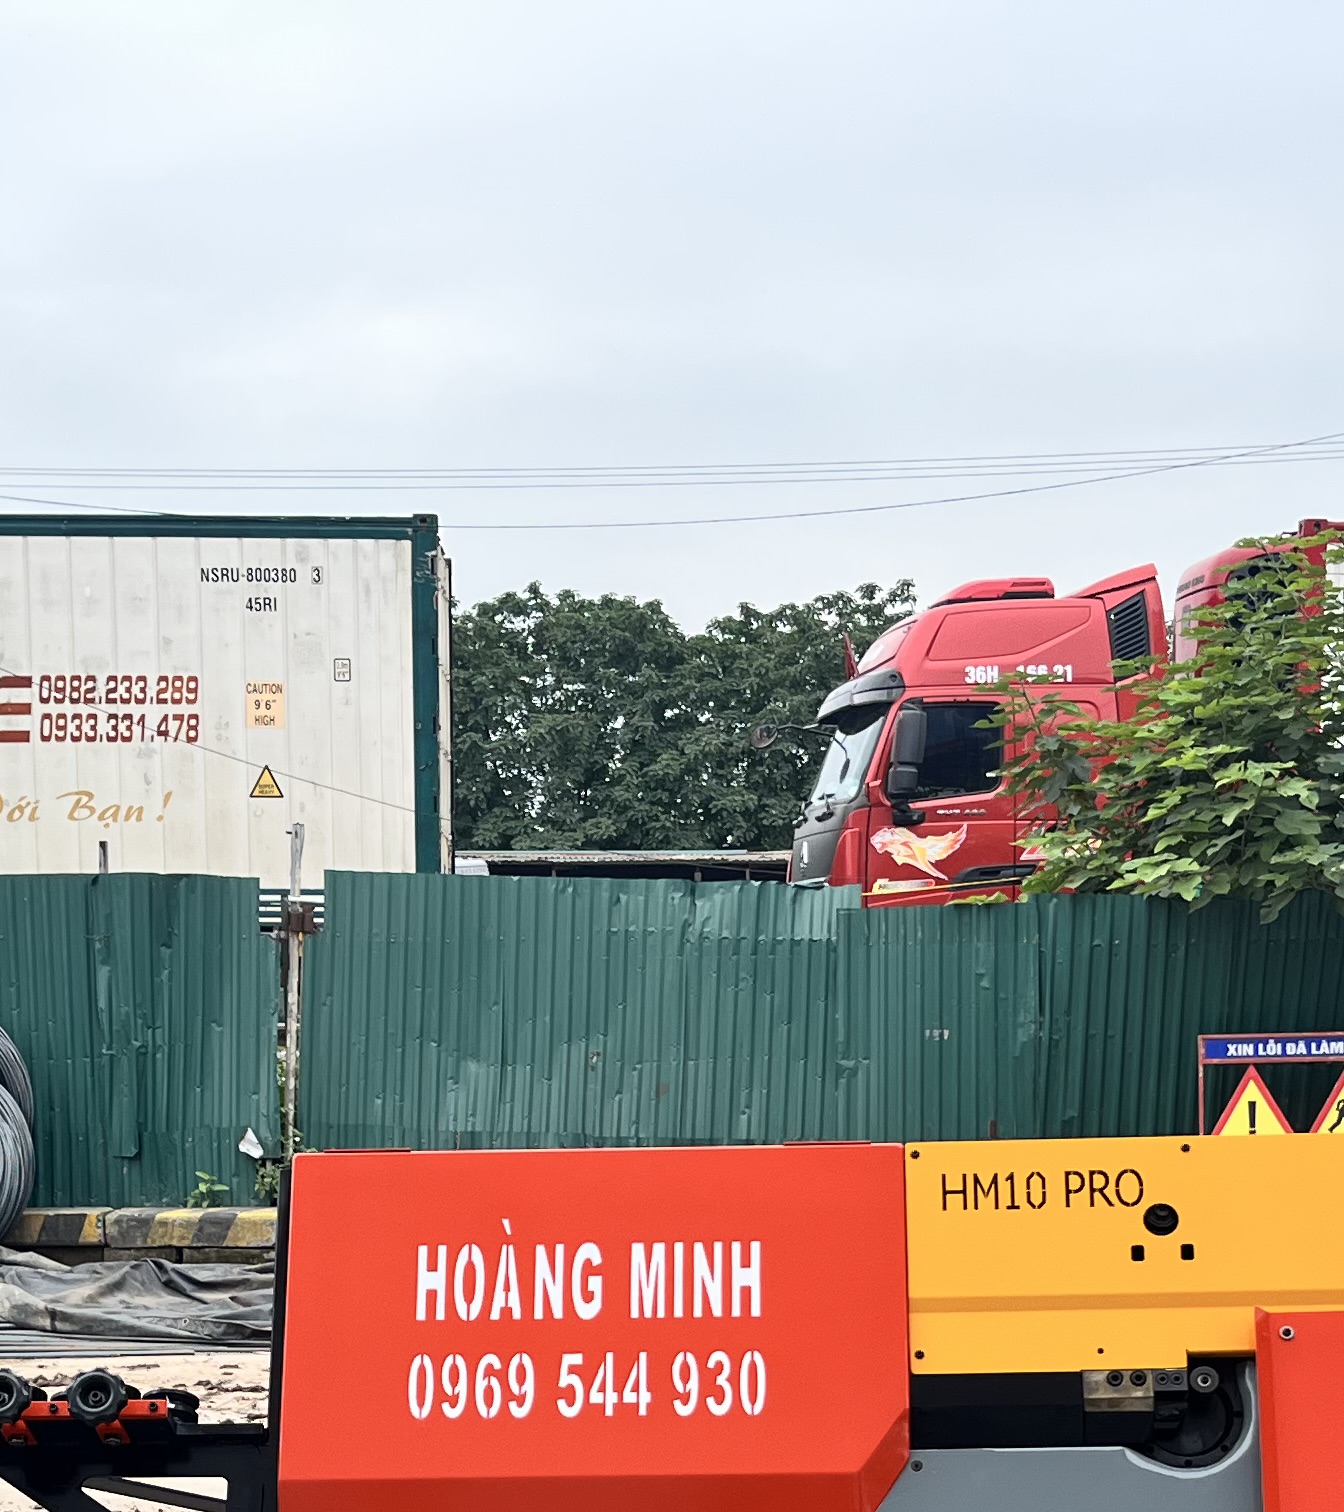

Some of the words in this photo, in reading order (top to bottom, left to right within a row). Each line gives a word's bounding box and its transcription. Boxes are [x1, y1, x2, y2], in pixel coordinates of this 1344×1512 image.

[312, 567, 322, 584] 3
[38, 674, 199, 705] 0982.233.289
[246, 683, 283, 695] CAUTION
[964, 665, 1000, 685] 36H
[39, 712, 200, 743] 0933.331.478
[254, 715, 276, 727] HIGH
[56, 790, 145, 829] Bạn
[1226, 1042, 1254, 1057] XIN
[1310, 1039, 1344, 1055] LÀM
[940, 1169, 1048, 1212] HM10
[1063, 1167, 1145, 1208] PRO
[414, 1218, 604, 1321] HOÀNG
[629, 1240, 762, 1319] MINH
[407, 1352, 535, 1420] 0969
[555, 1351, 652, 1417] 544
[671, 1350, 767, 1416] 930
